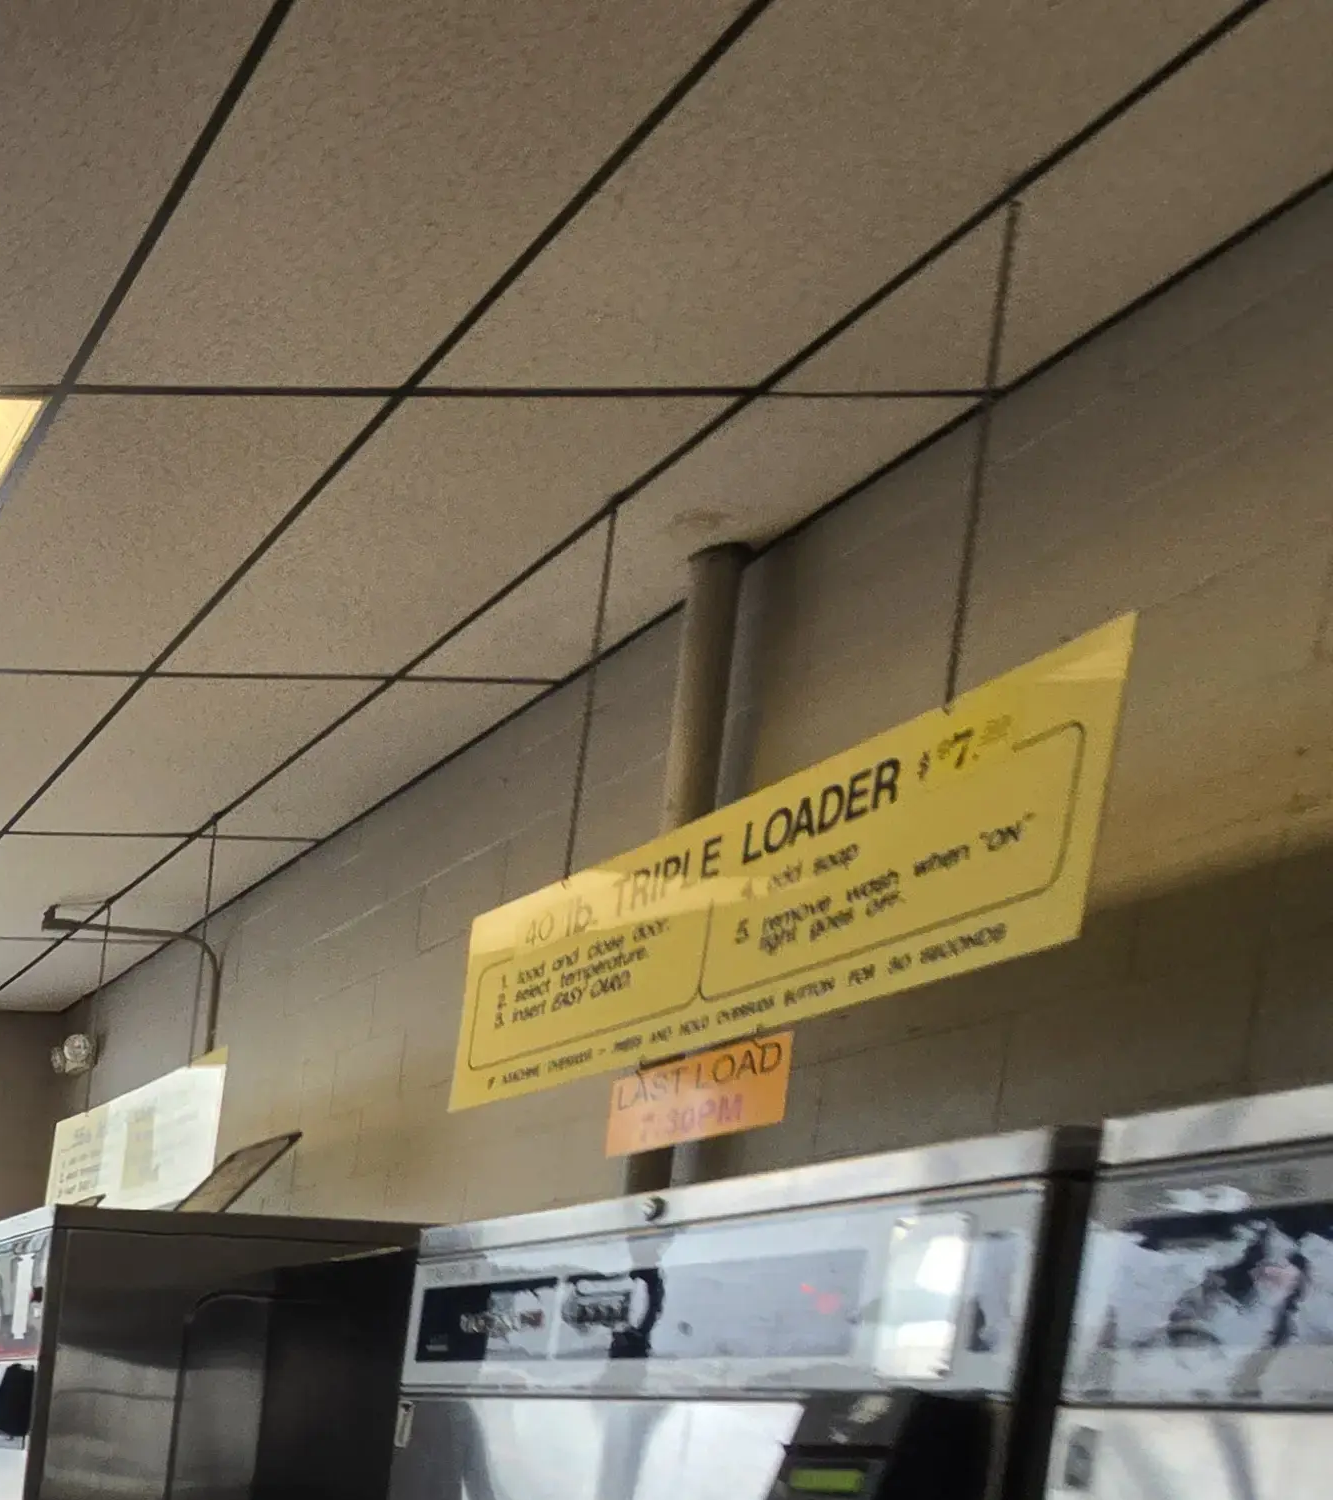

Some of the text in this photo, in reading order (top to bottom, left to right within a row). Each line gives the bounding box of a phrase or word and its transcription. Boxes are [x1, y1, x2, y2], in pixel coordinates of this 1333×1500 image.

[524, 911, 555, 946] 40
[613, 835, 723, 918] TRIPLE
[741, 756, 903, 866] LOADER
[812, 843, 861, 877] soap
[761, 895, 833, 932] remove
[845, 869, 900, 903] wash
[913, 844, 970, 878] when
[808, 906, 855, 943] goes
[516, 961, 546, 985] load
[552, 947, 580, 973] and
[586, 935, 625, 961] close
[649, 1025, 672, 1044] AND
[848, 963, 876, 987] FOR
[919, 922, 1008, 965] SECONDS
[512, 1000, 546, 1024] insert
[514, 978, 551, 1003] select
[617, 1041, 783, 1112] LAST LOAD
